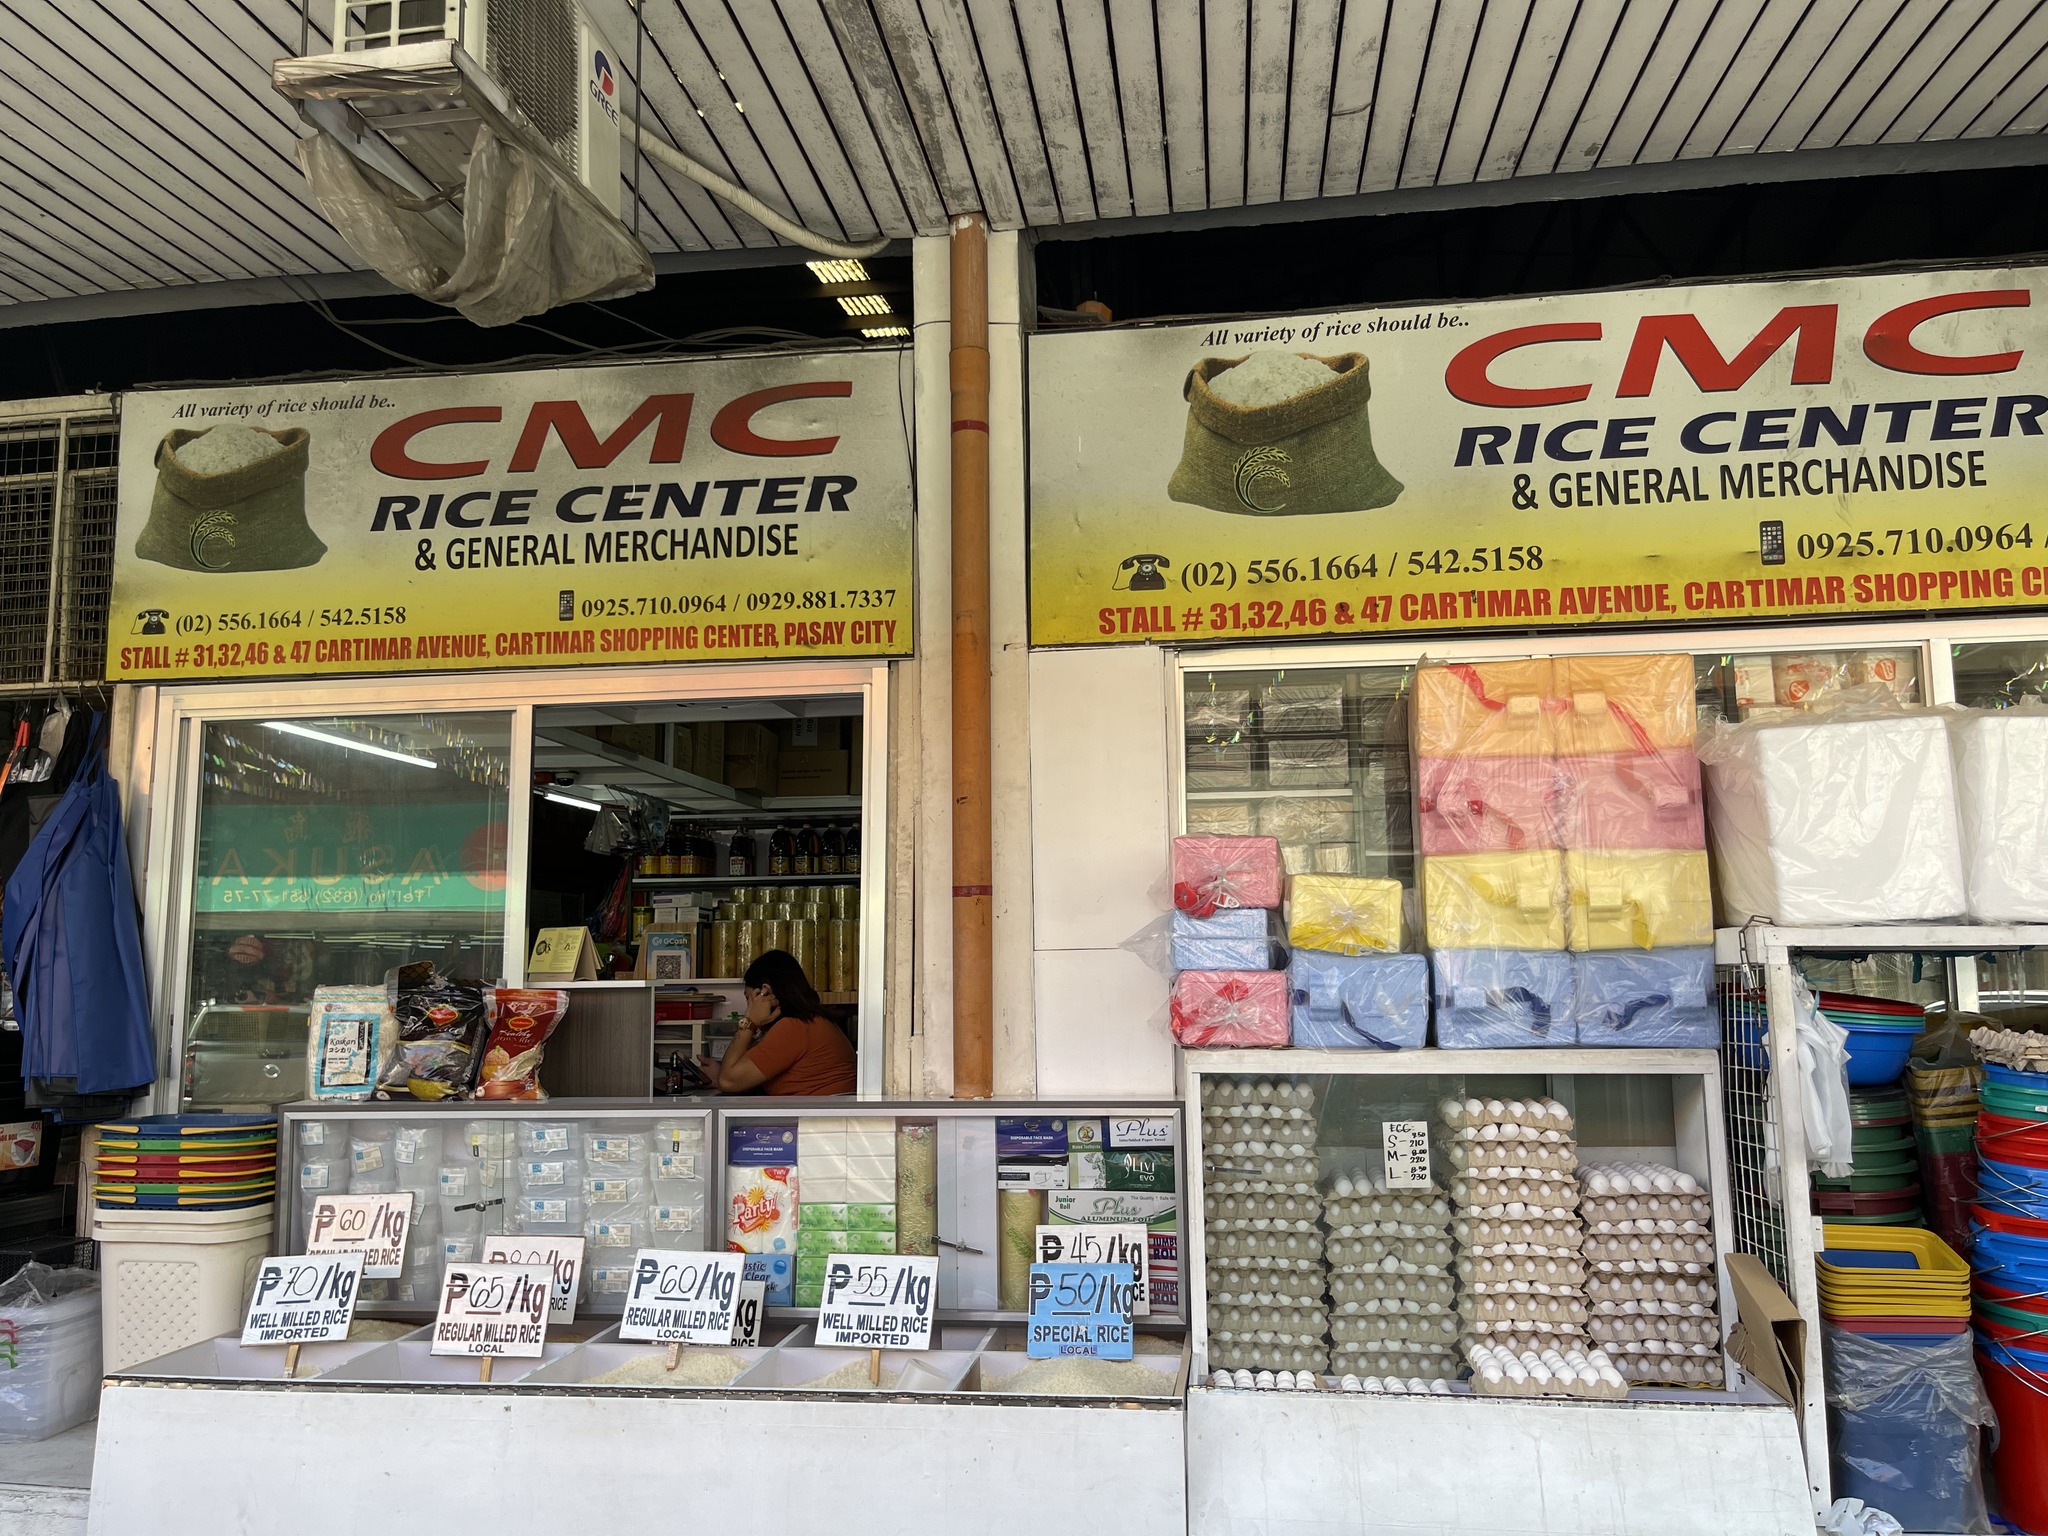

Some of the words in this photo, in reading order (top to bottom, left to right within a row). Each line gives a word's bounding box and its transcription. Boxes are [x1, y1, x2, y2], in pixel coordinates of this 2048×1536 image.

[590, 80, 618, 127] GREE
[1201, 329, 1229, 346] All
[1233, 326, 1297, 346] variety
[1301, 320, 1326, 342] of
[1325, 321, 1361, 337] rice
[1367, 314, 1432, 333] should
[1444, 289, 2032, 409] CMC
[171, 403, 197, 419] All
[200, 401, 253, 420] variety
[257, 399, 277, 417] of
[276, 398, 306, 414] rice
[311, 395, 366, 412] should
[370, 381, 853, 481] CMC
[1453, 416, 1656, 469] RICE
[1680, 394, 2048, 454] CENTER
[1511, 473, 1538, 510] &
[1549, 466, 1709, 508] GENERAL
[1720, 450, 1988, 501] MERCHANDISE
[370, 489, 538, 532] RICE
[555, 475, 858, 523] CENTER
[414, 538, 437, 571] &
[446, 533, 575, 569] GENERAL
[584, 523, 799, 564] MERCHANDISE
[1797, 522, 2034, 560] 0925.710.0964
[1181, 562, 1237, 591] (02)
[1247, 554, 1379, 585] 556.1664
[1387, 553, 1399, 578] /
[1407, 544, 1543, 577] 542.5158
[581, 594, 727, 617] 0925.710.0964
[732, 593, 741, 613] /
[746, 589, 897, 612] 0929.881.7337
[1098, 606, 1175, 636] STALL
[1181, 607, 1203, 631] #
[1210, 599, 1327, 632] 31,32,46
[1334, 602, 1355, 624] &
[1361, 596, 1392, 624] 47
[1400, 588, 1551, 619] CARTIMAR
[1558, 583, 1678, 616] AVENUE,
[1684, 575, 1845, 611] CARTIMAR
[1854, 569, 2013, 604] SHOPPING
[175, 615, 212, 636] (02)
[218, 609, 302, 632] 556.1664
[307, 609, 315, 628] /
[319, 606, 407, 627] 542.5158
[120, 646, 170, 670] STALL
[175, 648, 190, 667] #
[193, 642, 269, 670] 31,32,46
[273, 645, 287, 664] &
[291, 640, 311, 663] 47
[315, 636, 412, 662] CARTIMAR
[416, 634, 491, 660] AVENUE,
[495, 630, 595, 656] CARTIMAR
[600, 626, 698, 652] SHOPPING
[703, 623, 779, 649] CENTER,
[784, 621, 846, 646] PASAY
[850, 620, 897, 645] CITY
[663, 937, 688, 945] GCash
[1116, 1117, 1167, 1136] Plus
[1388, 1150, 1399, 1161] M
[1390, 1167, 1401, 1179] L
[733, 1192, 778, 1224] Party!
[1091, 1197, 1139, 1215] Plus
[380, 1248, 401, 1265] RICE
[250, 1313, 278, 1329] WELL
[281, 1310, 321, 1327] MILLED
[322, 1309, 349, 1325] RICE
[626, 1307, 671, 1327] REGULAR
[672, 1310, 706, 1329] MILLED
[708, 1311, 730, 1330] RICE
[823, 1313, 853, 1329] WELL
[857, 1315, 898, 1331] MILLED
[901, 1316, 928, 1333] RICE
[260, 1327, 329, 1340] IMPORTED
[438, 1323, 482, 1341] REGULAR
[484, 1323, 517, 1343] MILLED
[519, 1325, 541, 1343] RICE
[657, 1330, 693, 1339] LOCAL
[836, 1331, 909, 1345] IMPORTED
[1034, 1325, 1092, 1343] SPECIAL
[1097, 1325, 1129, 1343] RICE
[469, 1344, 504, 1353] LOCAL
[1060, 1346, 1097, 1354] LOCAL
